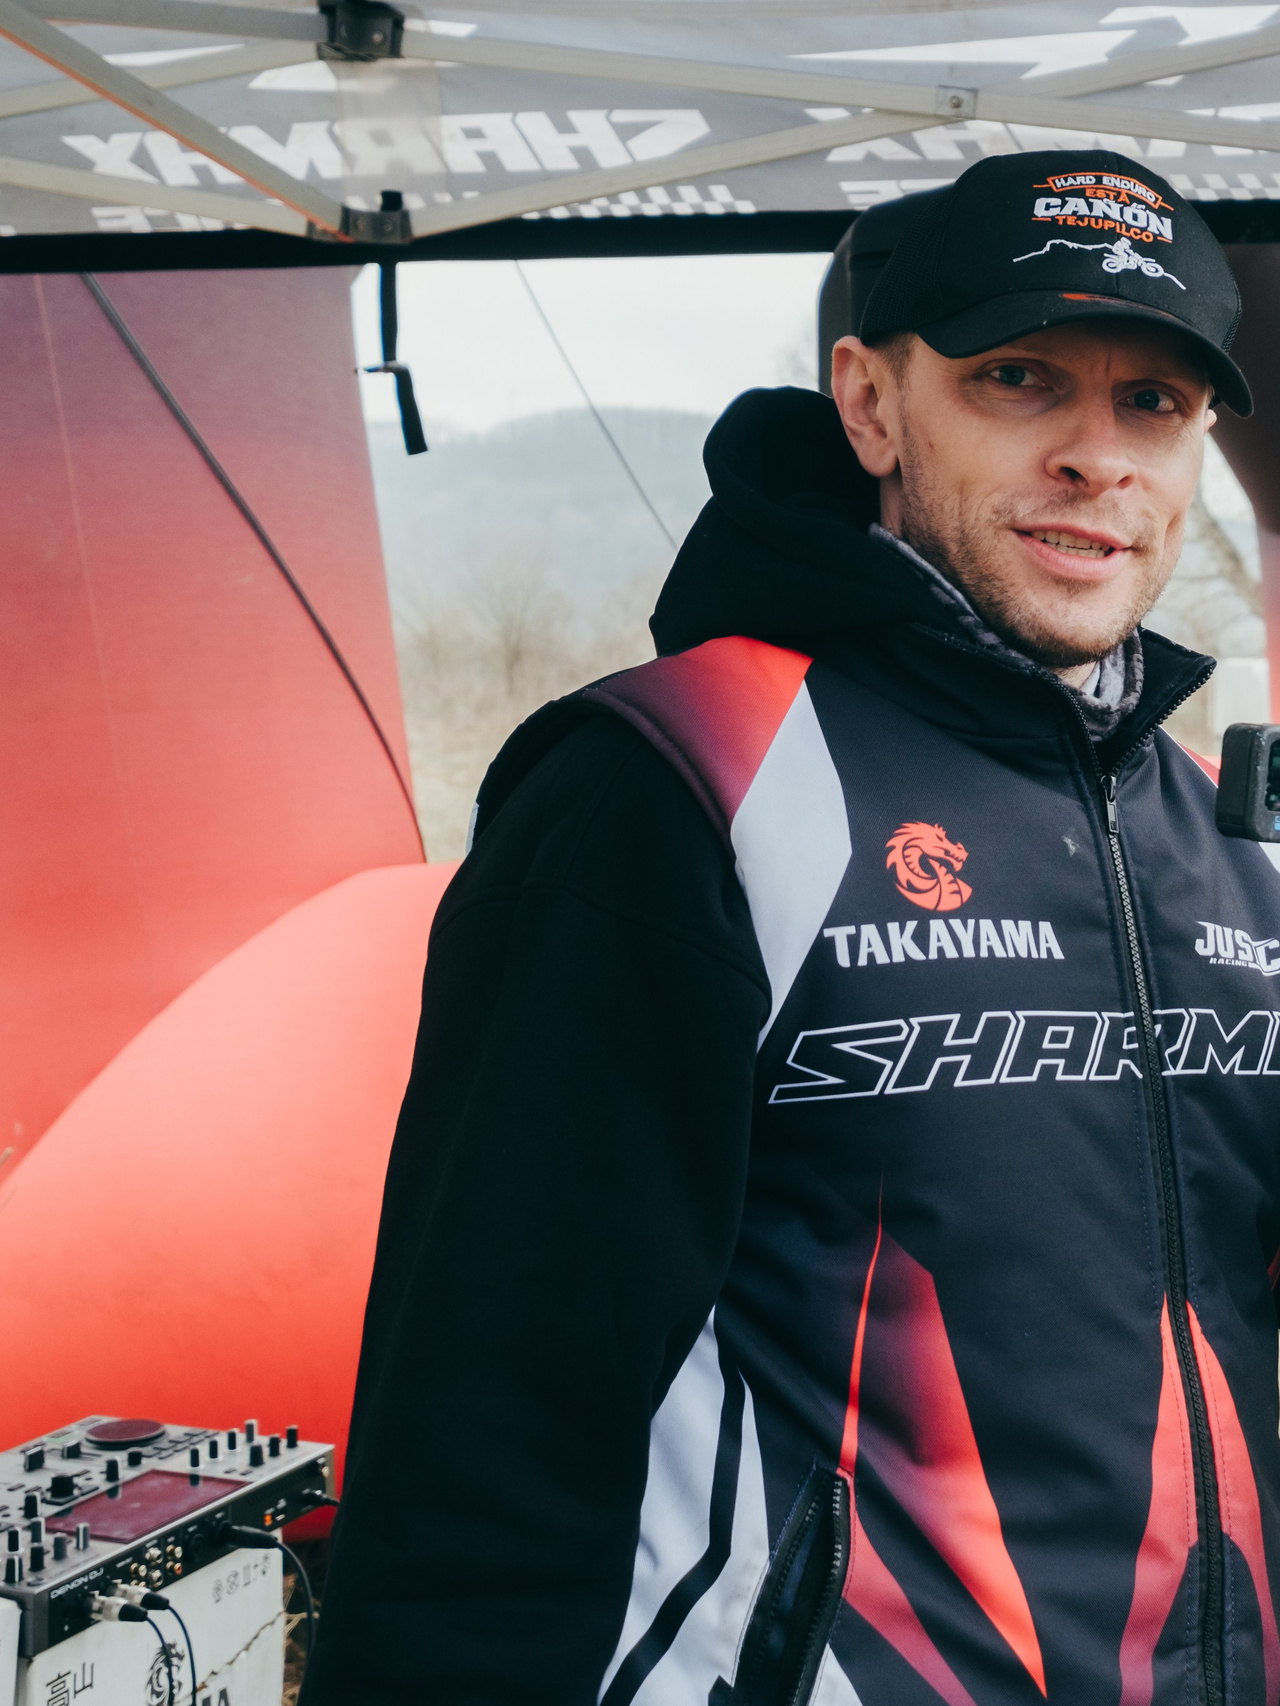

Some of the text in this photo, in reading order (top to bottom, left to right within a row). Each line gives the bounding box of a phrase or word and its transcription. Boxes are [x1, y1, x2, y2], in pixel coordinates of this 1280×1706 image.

[1054, 175, 1156, 203] HARD ENDURO
[1055, 215, 1154, 243] TEJUPILCO
[824, 919, 1065, 967] TAKAYAMA
[1209, 957, 1248, 967] RACING
